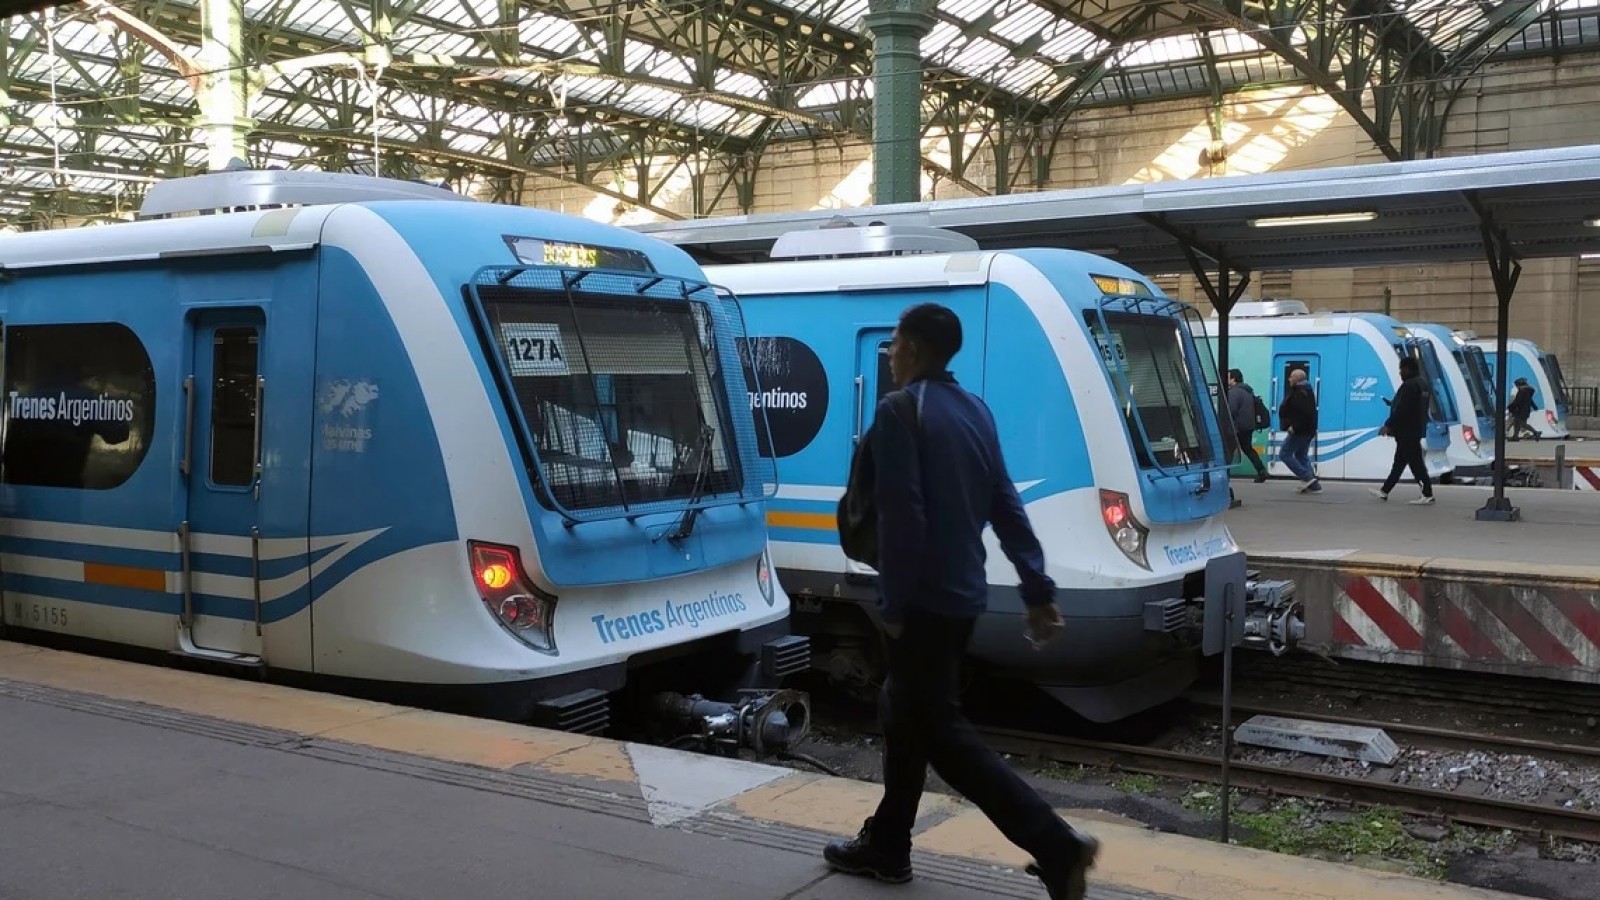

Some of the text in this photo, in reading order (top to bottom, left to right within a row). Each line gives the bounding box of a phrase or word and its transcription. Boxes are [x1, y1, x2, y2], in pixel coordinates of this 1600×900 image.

[509, 337, 562, 361] 127A
[9, 391, 134, 426] Trenes Argentinos
[747, 386, 807, 411] gentinos
[33, 604, 68, 626] 5155
[592, 591, 747, 644] Trenes Argentinos
